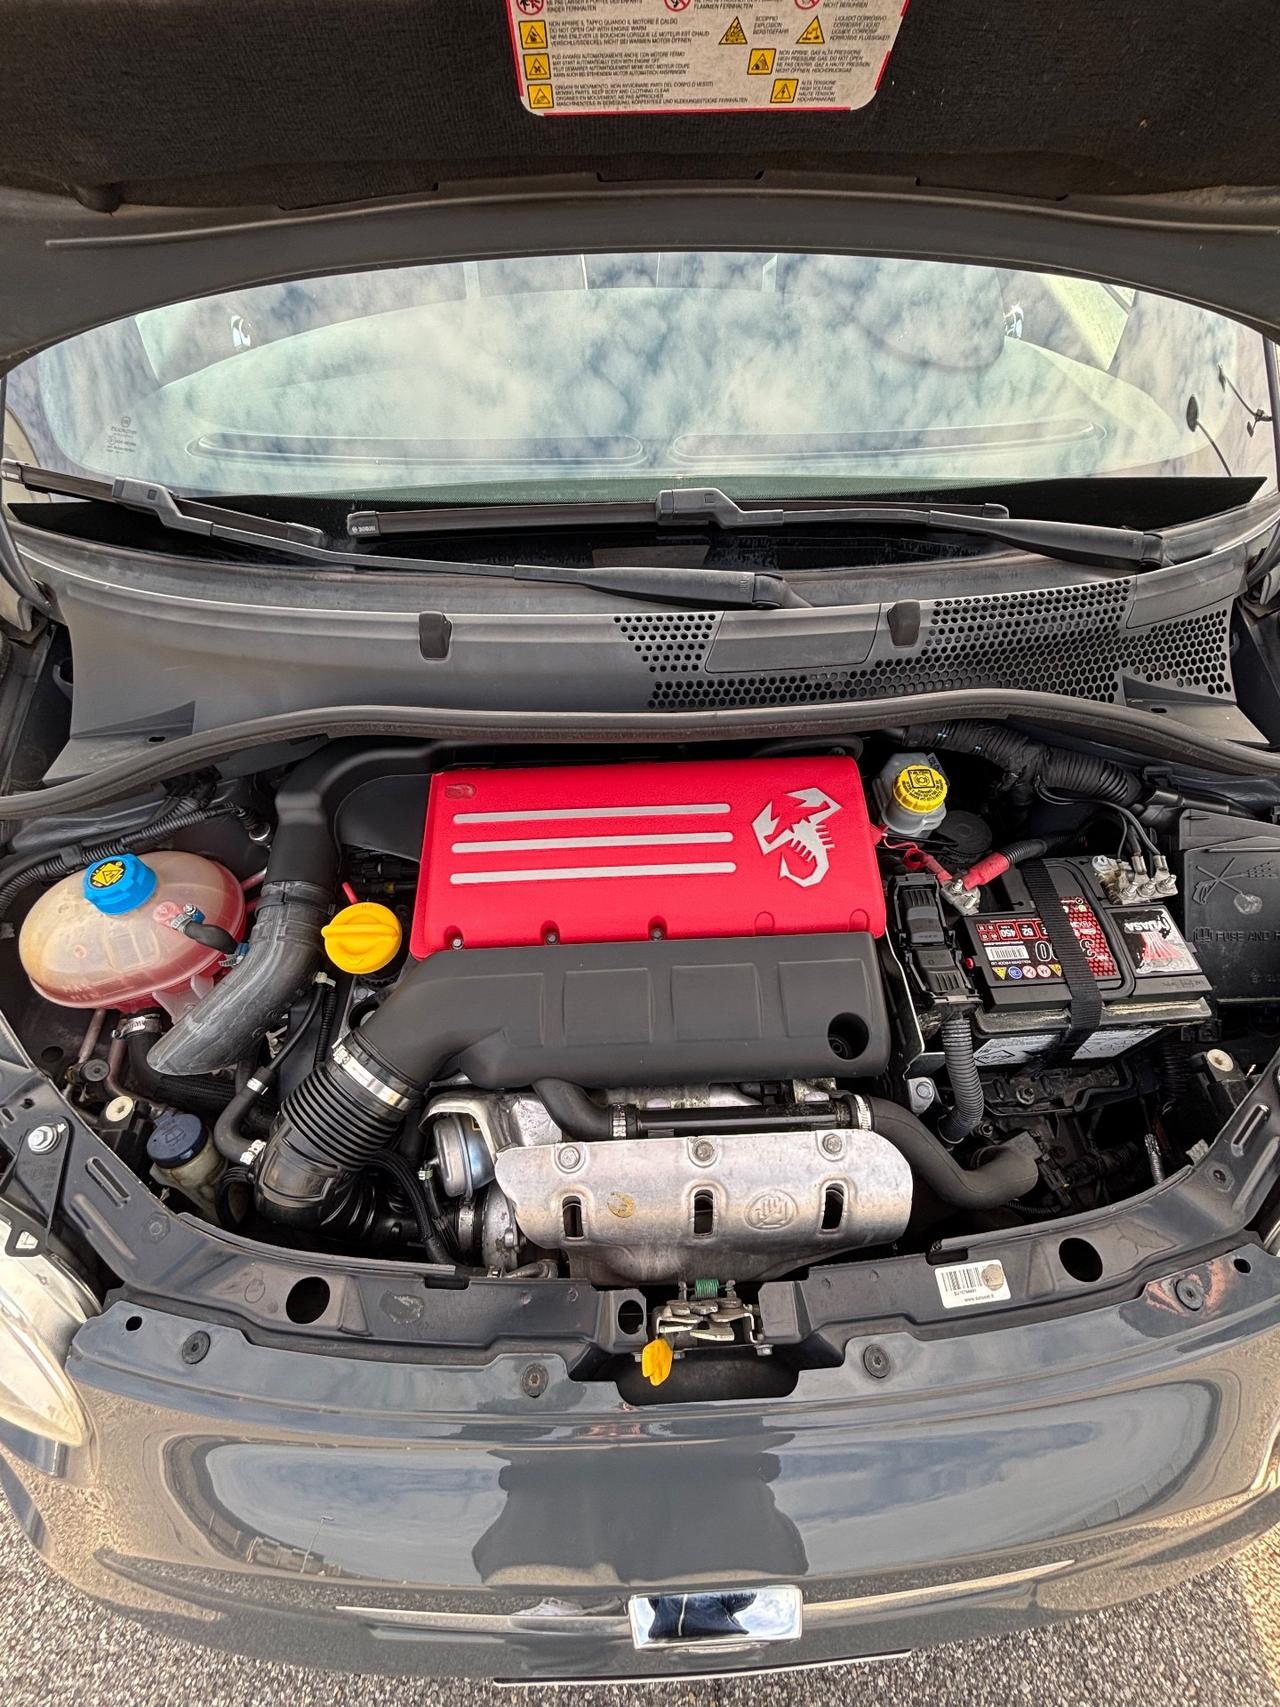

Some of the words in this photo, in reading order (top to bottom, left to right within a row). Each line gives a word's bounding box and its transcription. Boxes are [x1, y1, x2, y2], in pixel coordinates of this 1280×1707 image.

[1124, 914, 1168, 932] YUASA
[1001, 929, 1016, 938] 450
[1022, 928, 1034, 936] 52
[1216, 930, 1244, 942] FUSE
[1248, 930, 1268, 942] AND
